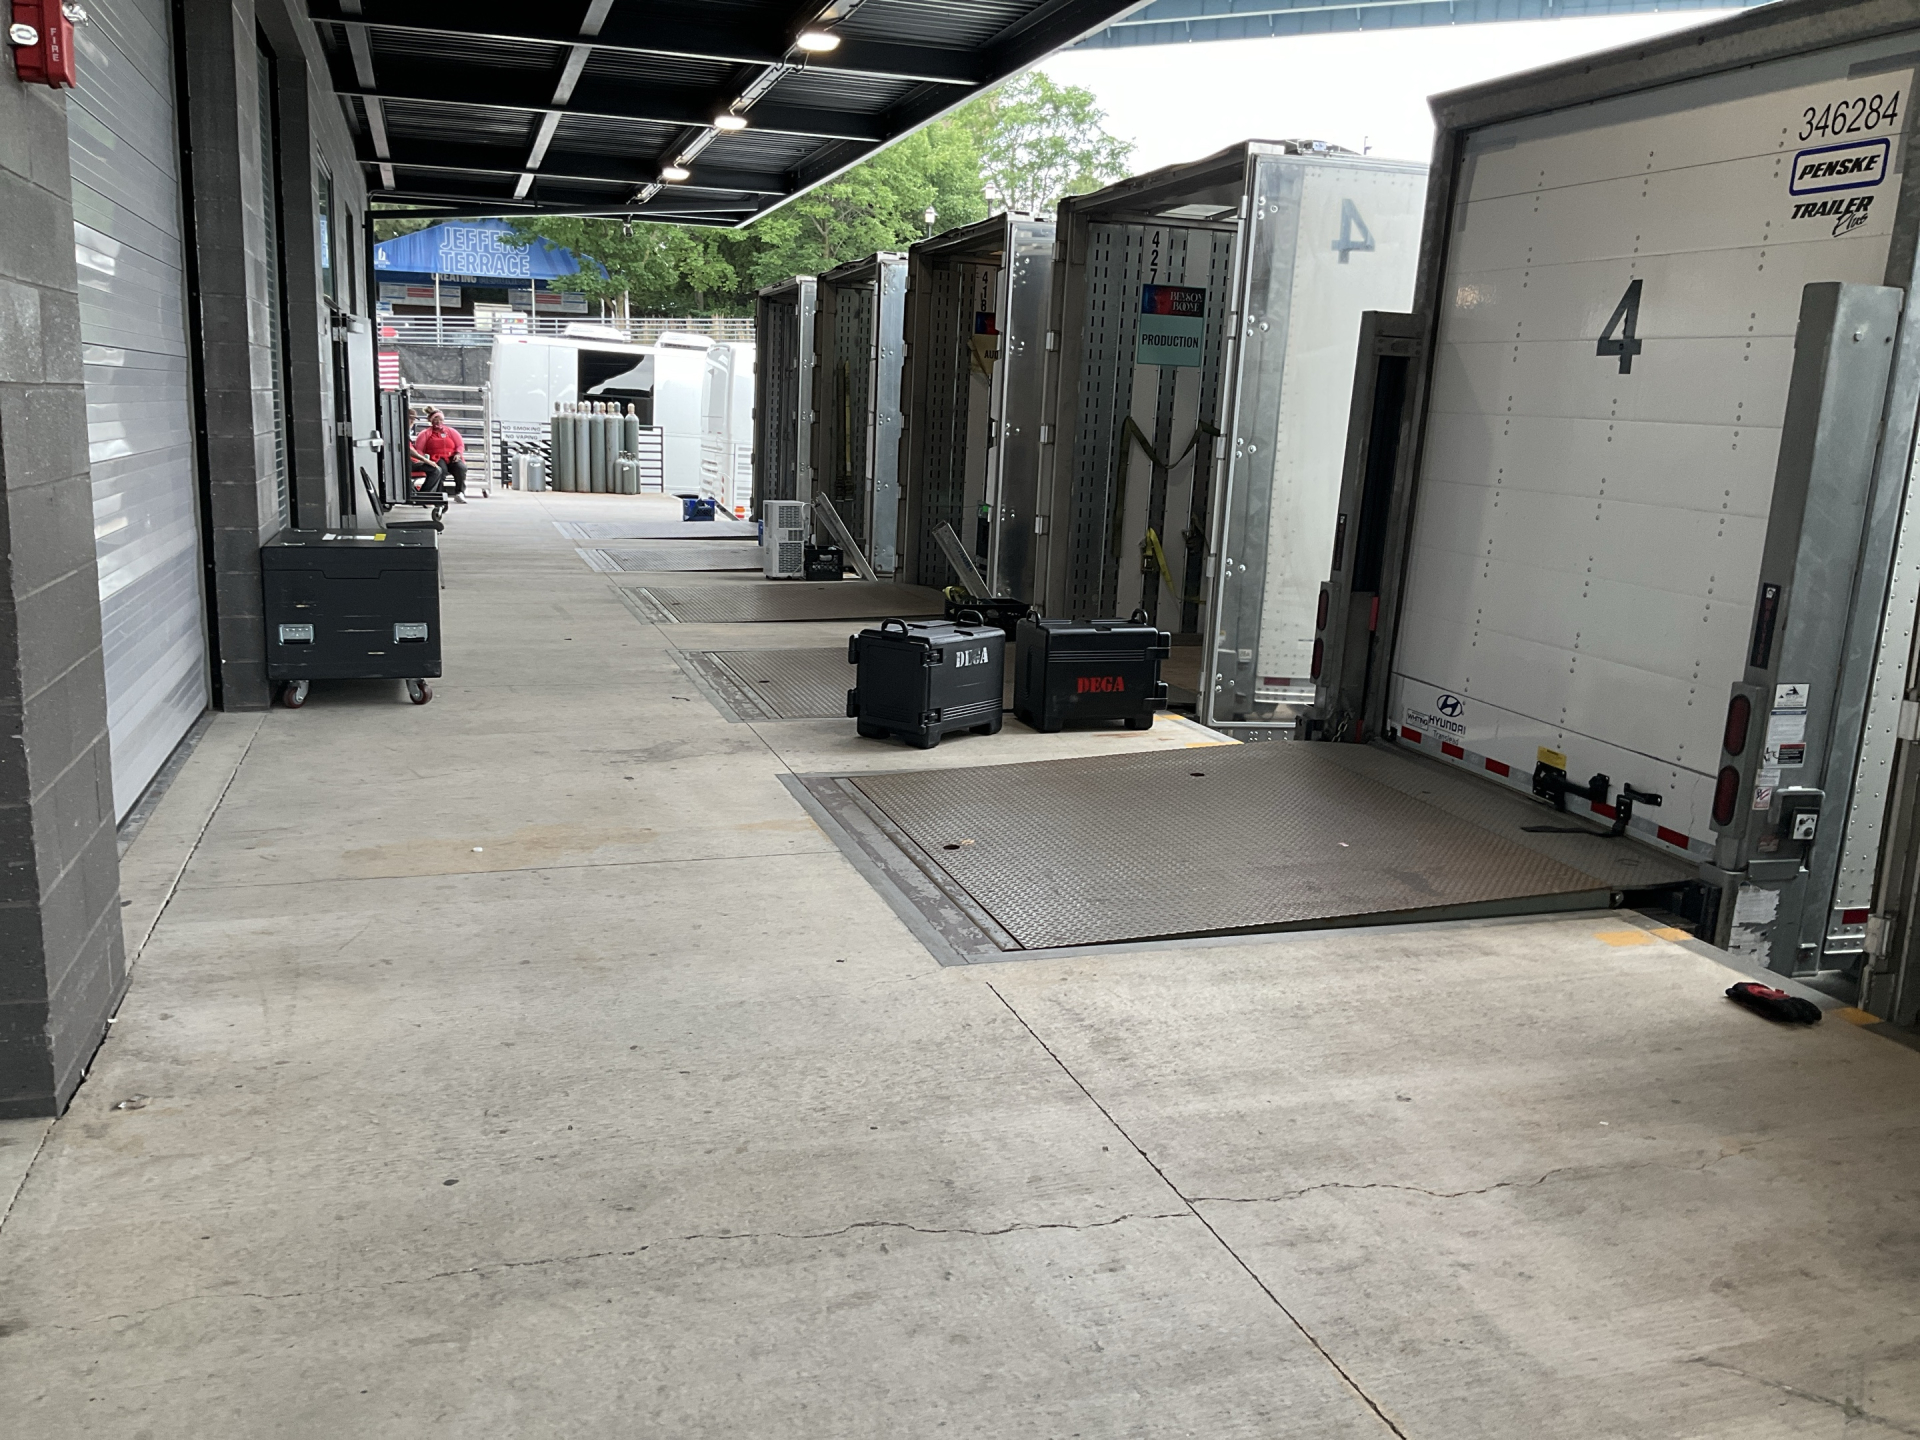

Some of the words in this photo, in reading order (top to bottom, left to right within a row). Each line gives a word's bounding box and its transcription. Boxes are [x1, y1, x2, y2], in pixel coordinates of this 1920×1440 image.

[50, 28, 60, 62] FIRE
[1798, 90, 1900, 141] 346284
[1797, 154, 1881, 181] PENSKE
[1791, 195, 1875, 220] TRAILER
[1832, 211, 1869, 236] Plus
[440, 250, 530, 276] TERRACE
[1170, 291, 1204, 303] BENSON
[1173, 301, 1200, 312] BOONE
[1596, 279, 1643, 374] 4
[1141, 333, 1199, 349] PRODUCTION
[1077, 676, 1125, 694] DEGA
[1407, 713, 1428, 726] WHITING
[1429, 714, 1466, 736] HYUNDAI
[1433, 729, 1459, 746] Translead
